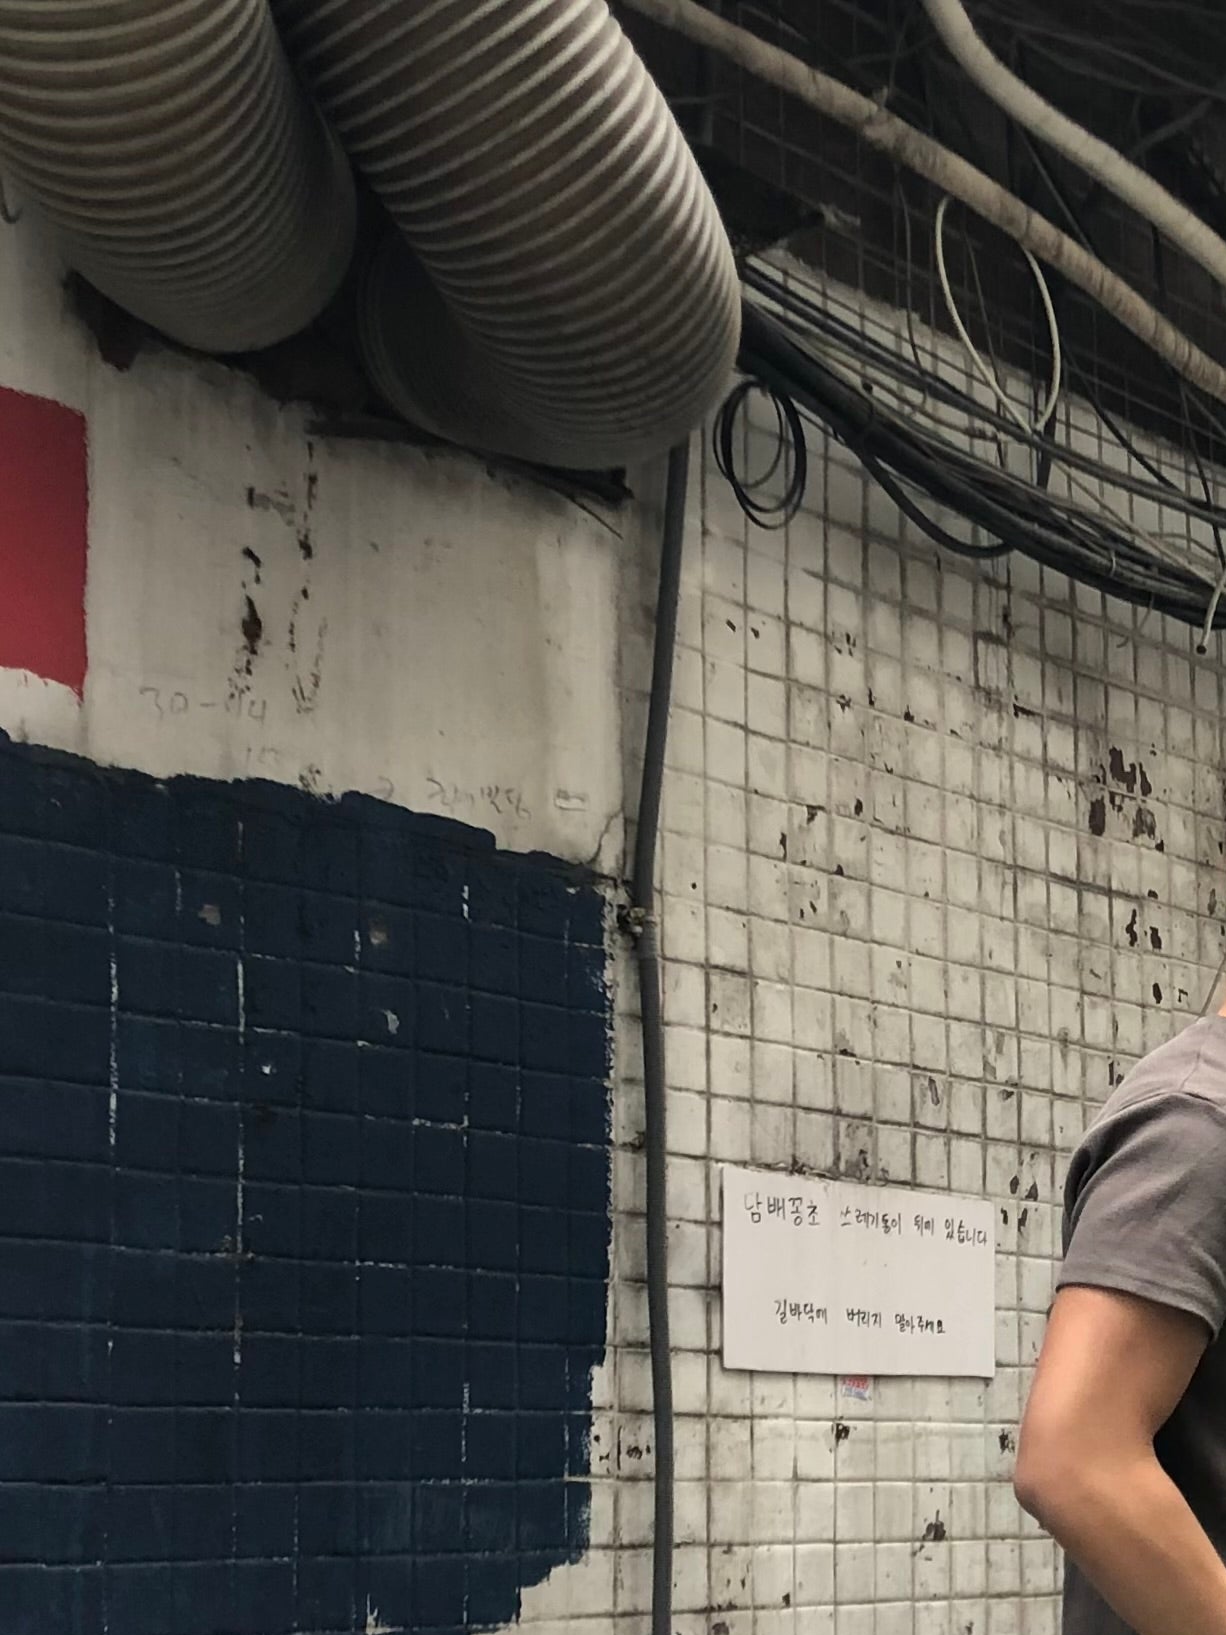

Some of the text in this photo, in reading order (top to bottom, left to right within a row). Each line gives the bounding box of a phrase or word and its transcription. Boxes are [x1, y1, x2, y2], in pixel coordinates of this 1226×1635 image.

[743, 1191, 820, 1226] 담배꽁초
[943, 1217, 988, 1247] 있습니다
[774, 1298, 828, 1325] 길바닥에
[846, 1307, 882, 1329] 버리지
